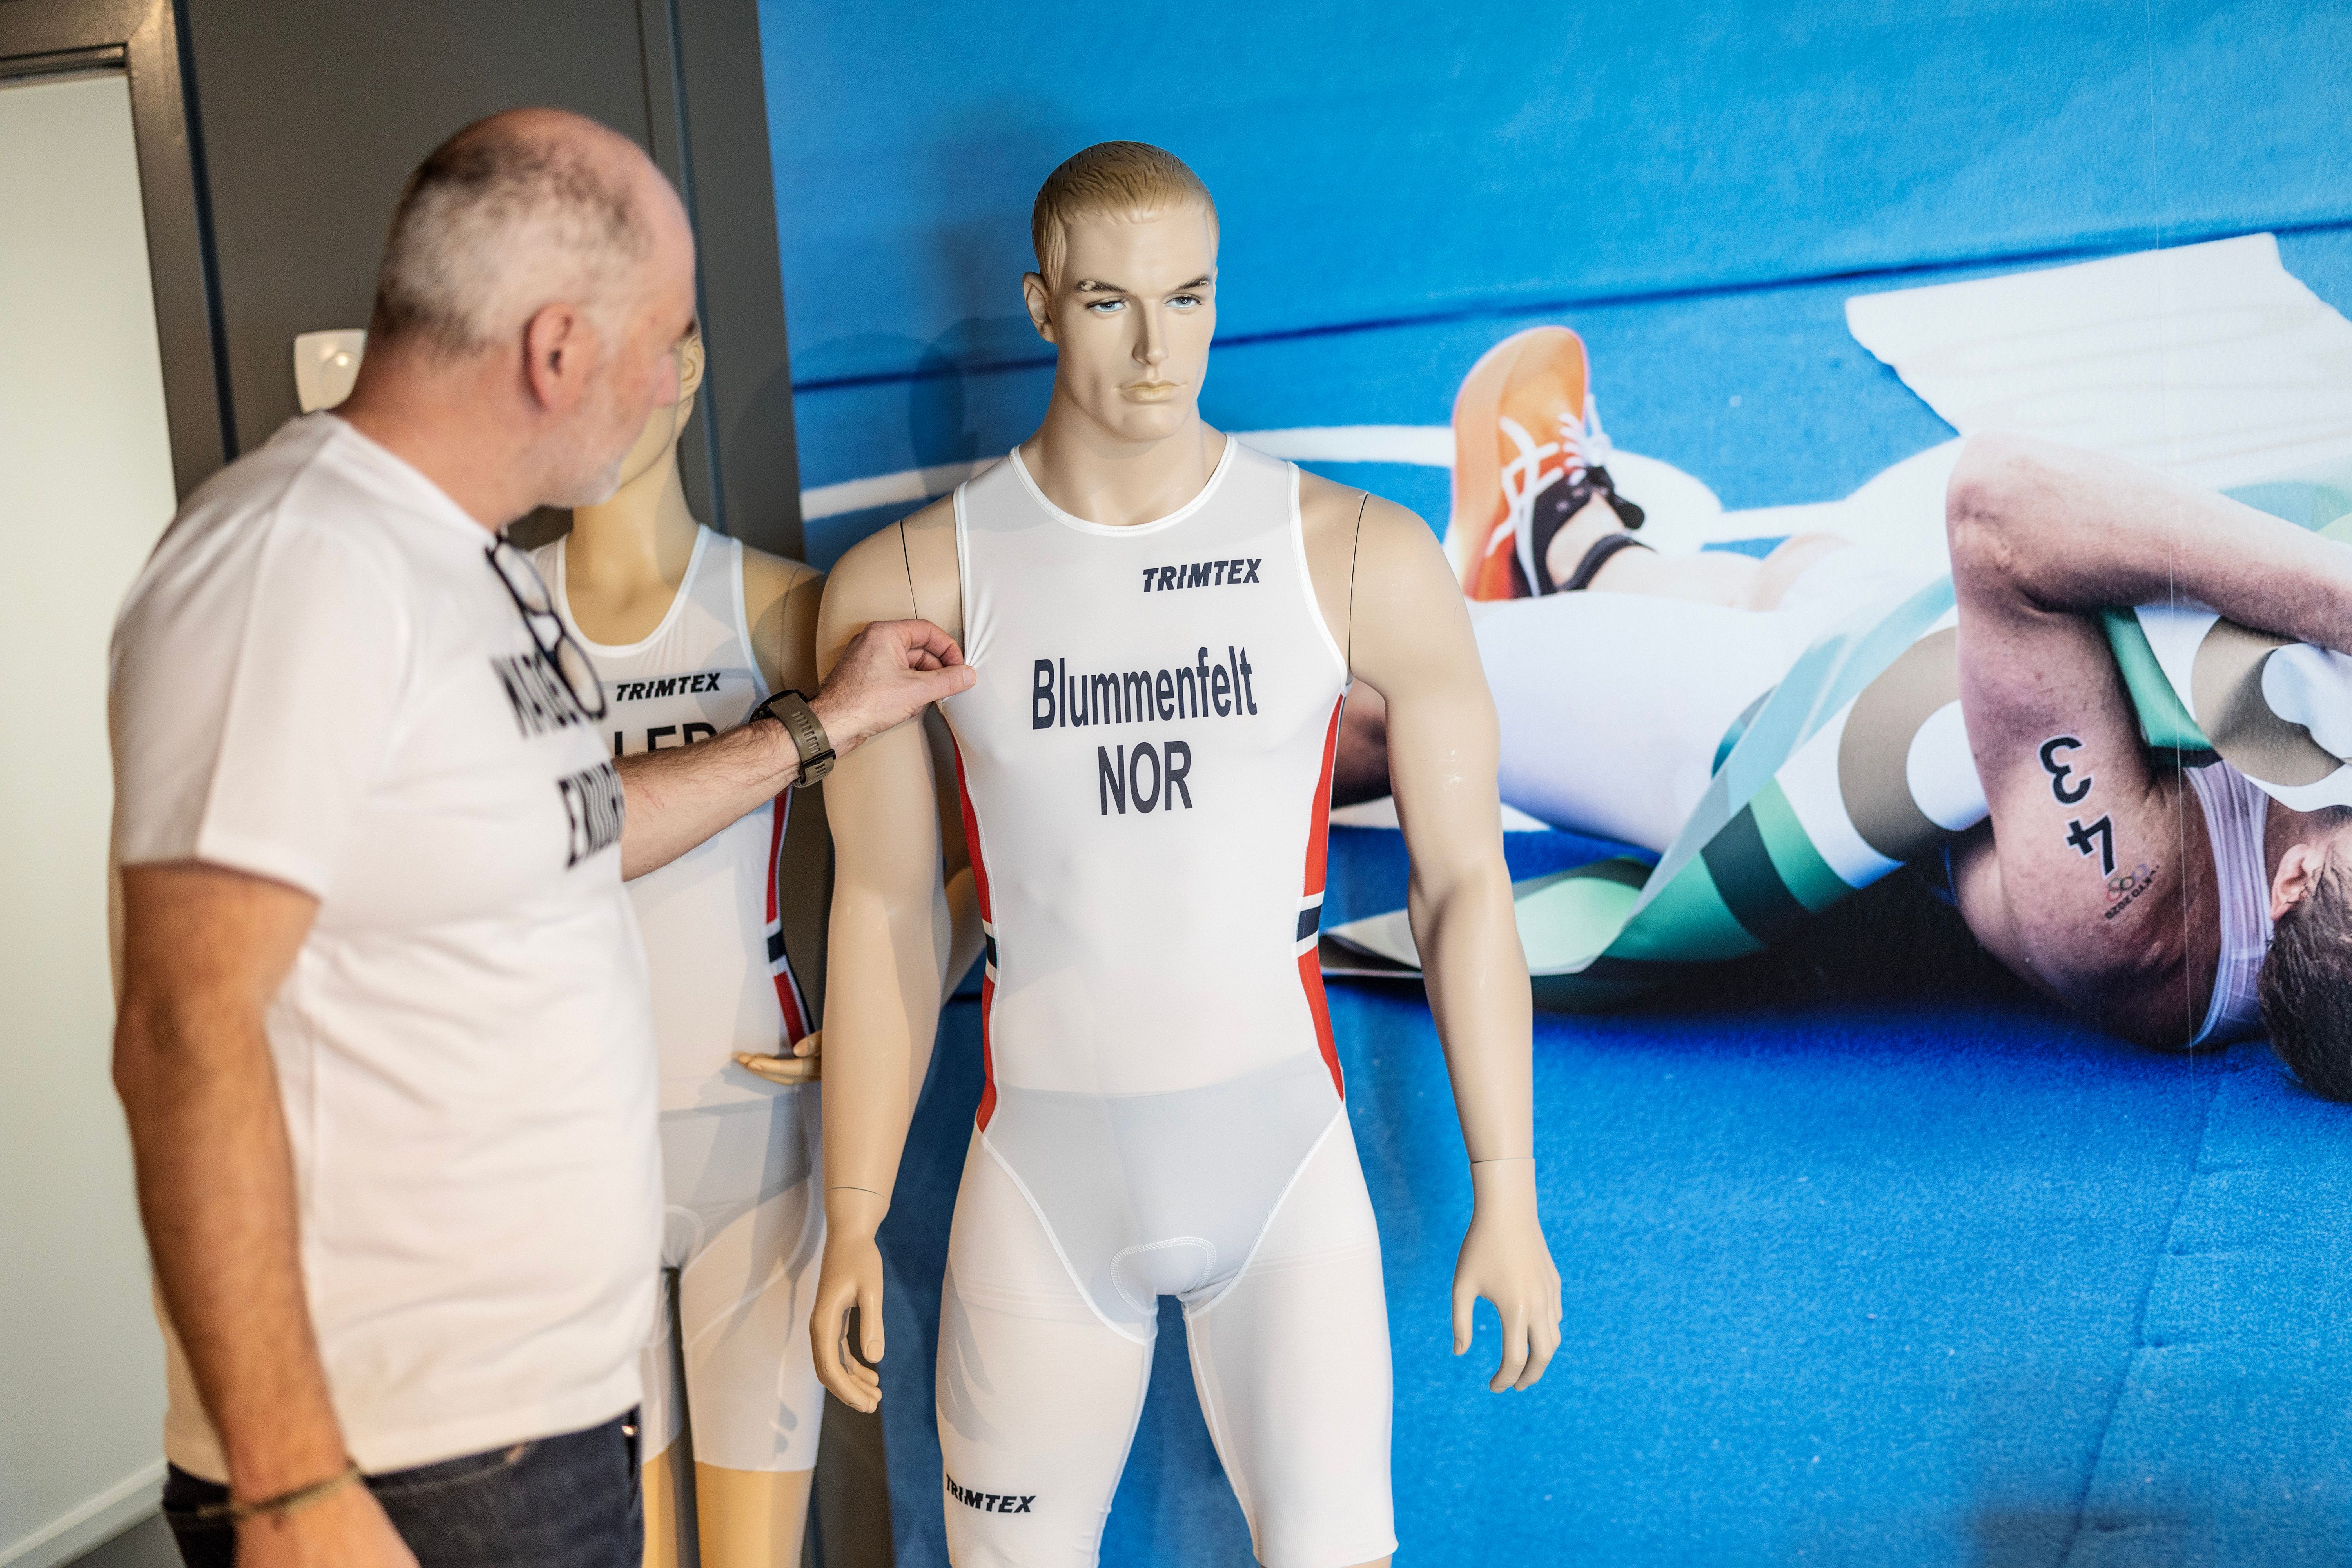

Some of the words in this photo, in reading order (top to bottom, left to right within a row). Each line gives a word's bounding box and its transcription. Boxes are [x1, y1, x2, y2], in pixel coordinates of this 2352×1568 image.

[1143, 559, 1262, 593] TRIMTEX
[616, 672, 721, 702] TRIMTEX
[1033, 646, 1258, 730] Blummenfelt
[1098, 740, 1193, 815] NOR
[946, 1473, 1036, 1513] TRIMTEX
